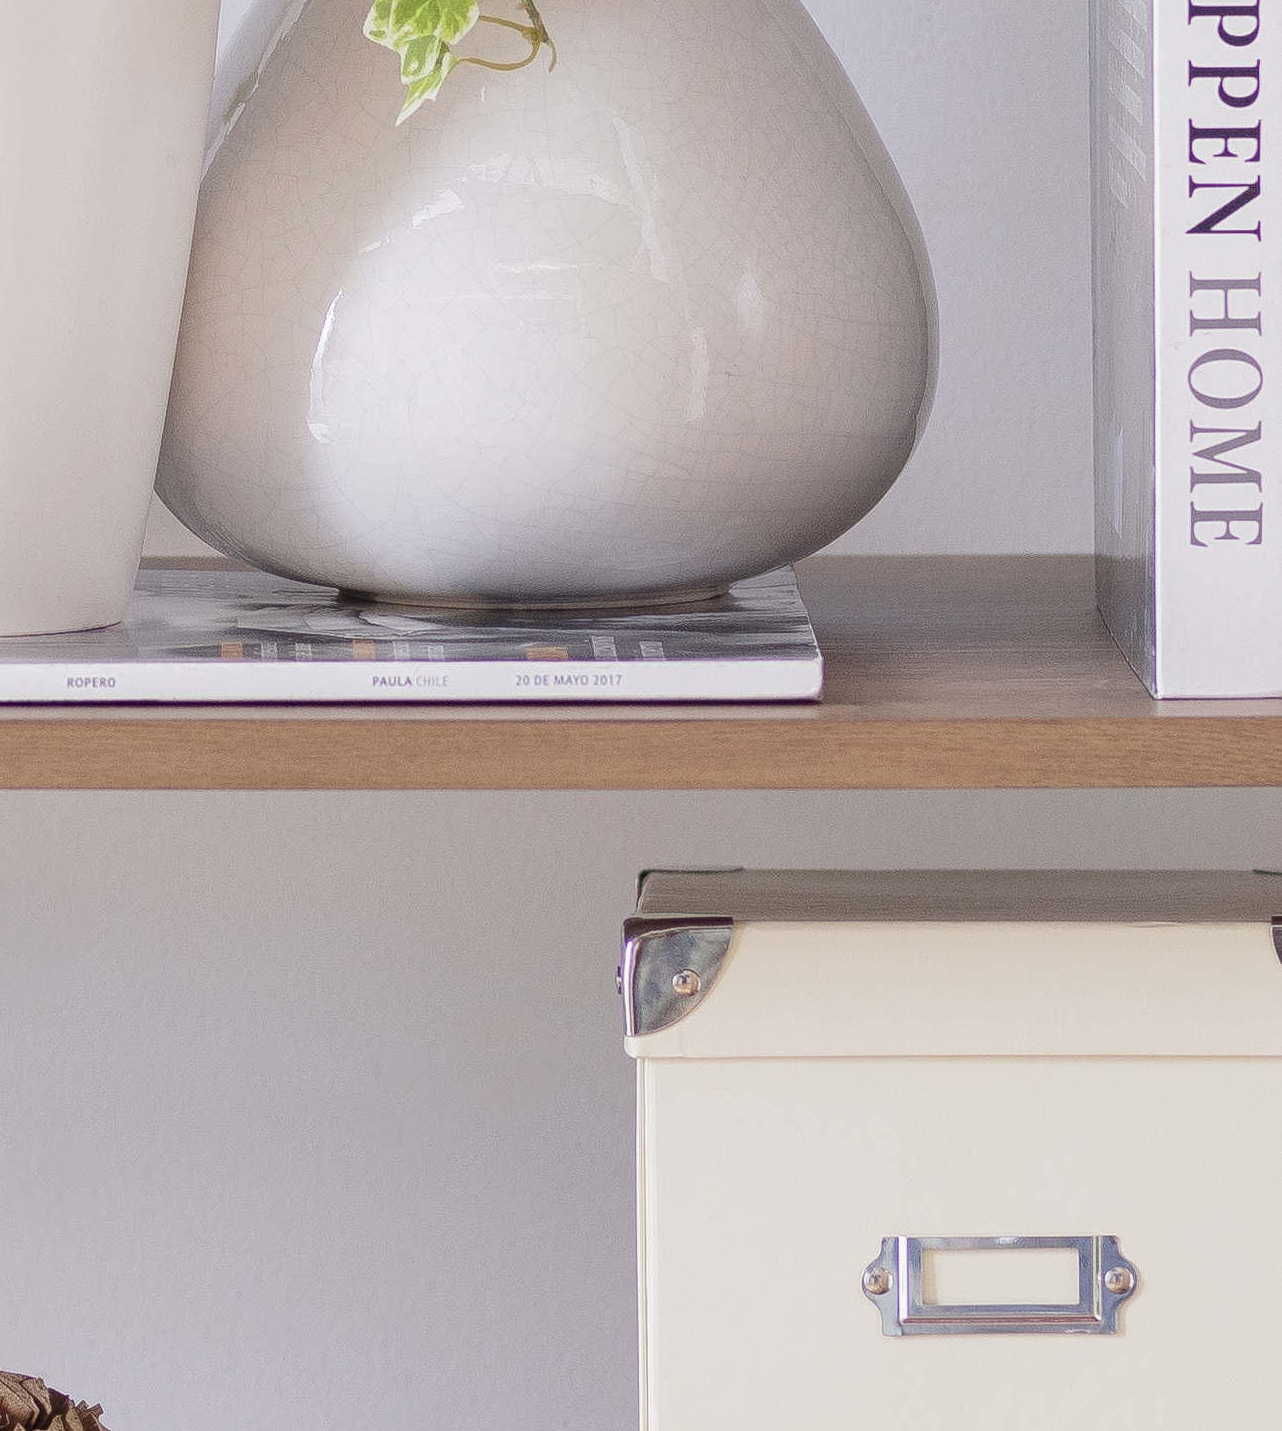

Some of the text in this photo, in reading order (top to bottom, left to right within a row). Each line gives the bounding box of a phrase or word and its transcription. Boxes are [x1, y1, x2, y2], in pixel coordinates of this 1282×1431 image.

[1187, 271, 1264, 548] HOME
[66, 676, 117, 690] ROPERO
[372, 675, 413, 688] PAULA
[415, 675, 449, 688] CHILE
[515, 674, 531, 687] 20
[533, 674, 550, 687] DE
[553, 674, 589, 687] MAYO
[592, 674, 623, 687] 2017
